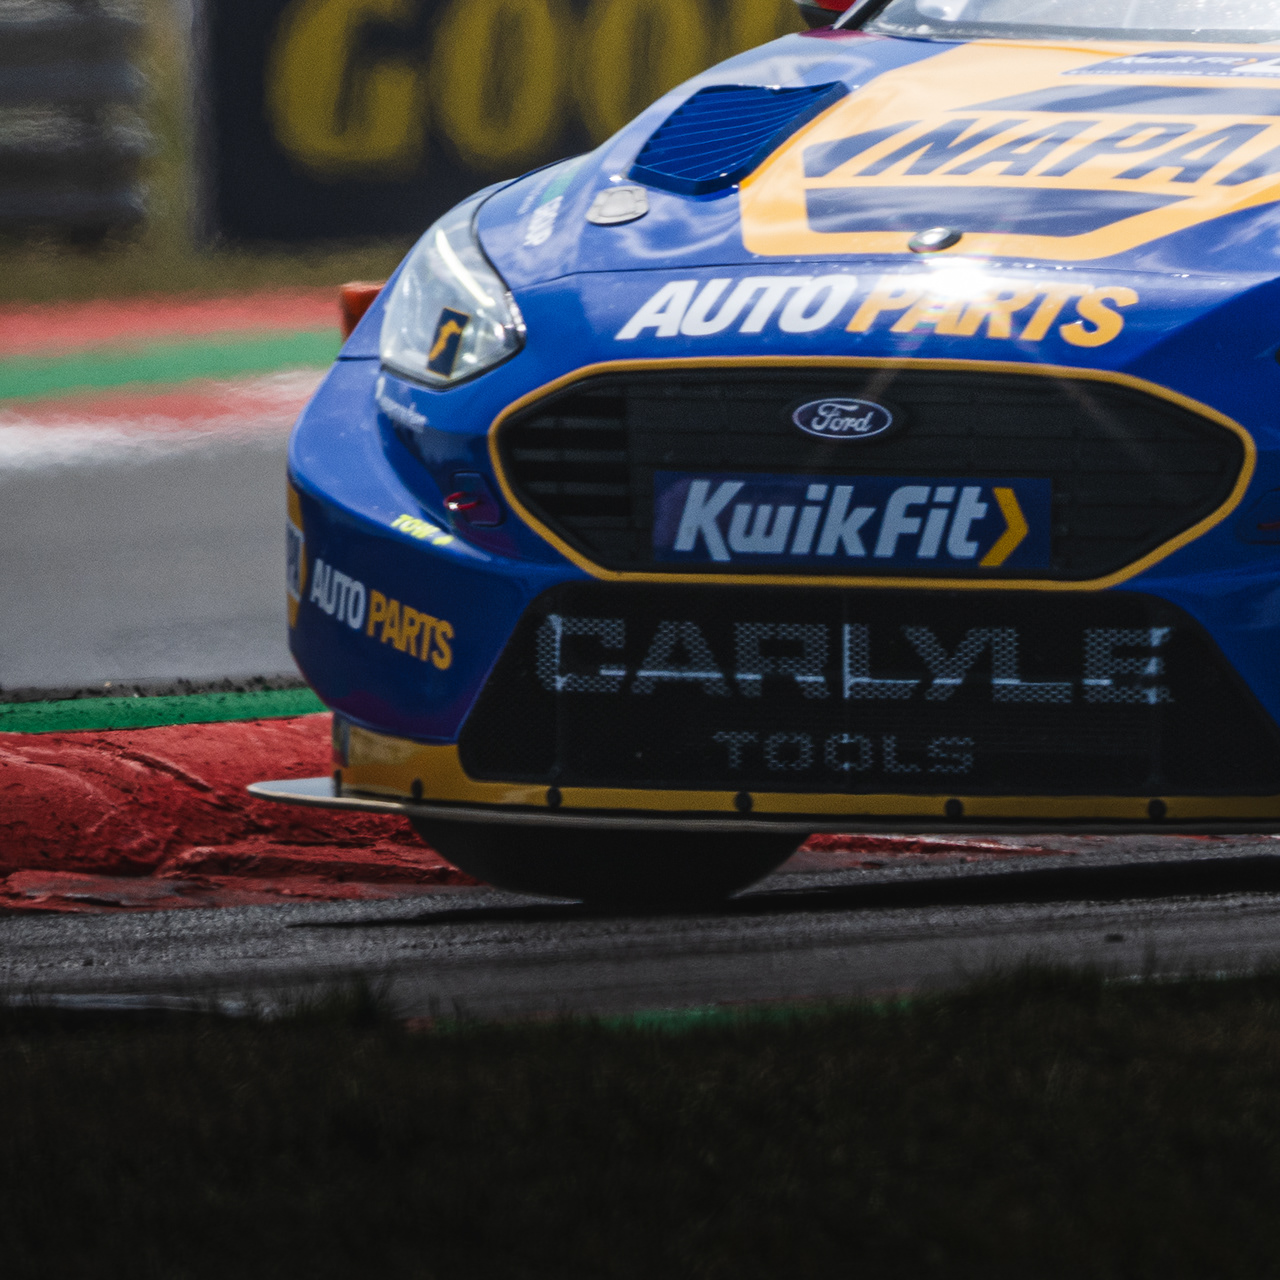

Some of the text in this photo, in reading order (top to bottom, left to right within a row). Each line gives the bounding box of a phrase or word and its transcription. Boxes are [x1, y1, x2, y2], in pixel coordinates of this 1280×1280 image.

[860, 116, 1247, 187] NAPA
[615, 274, 1139, 349] AUTO PARTS
[810, 401, 874, 434] Ford
[310, 558, 366, 630] AUTO
[366, 589, 456, 671] PARTS
[533, 613, 1177, 706] CARLYLE
[713, 730, 976, 776] TOOLS
